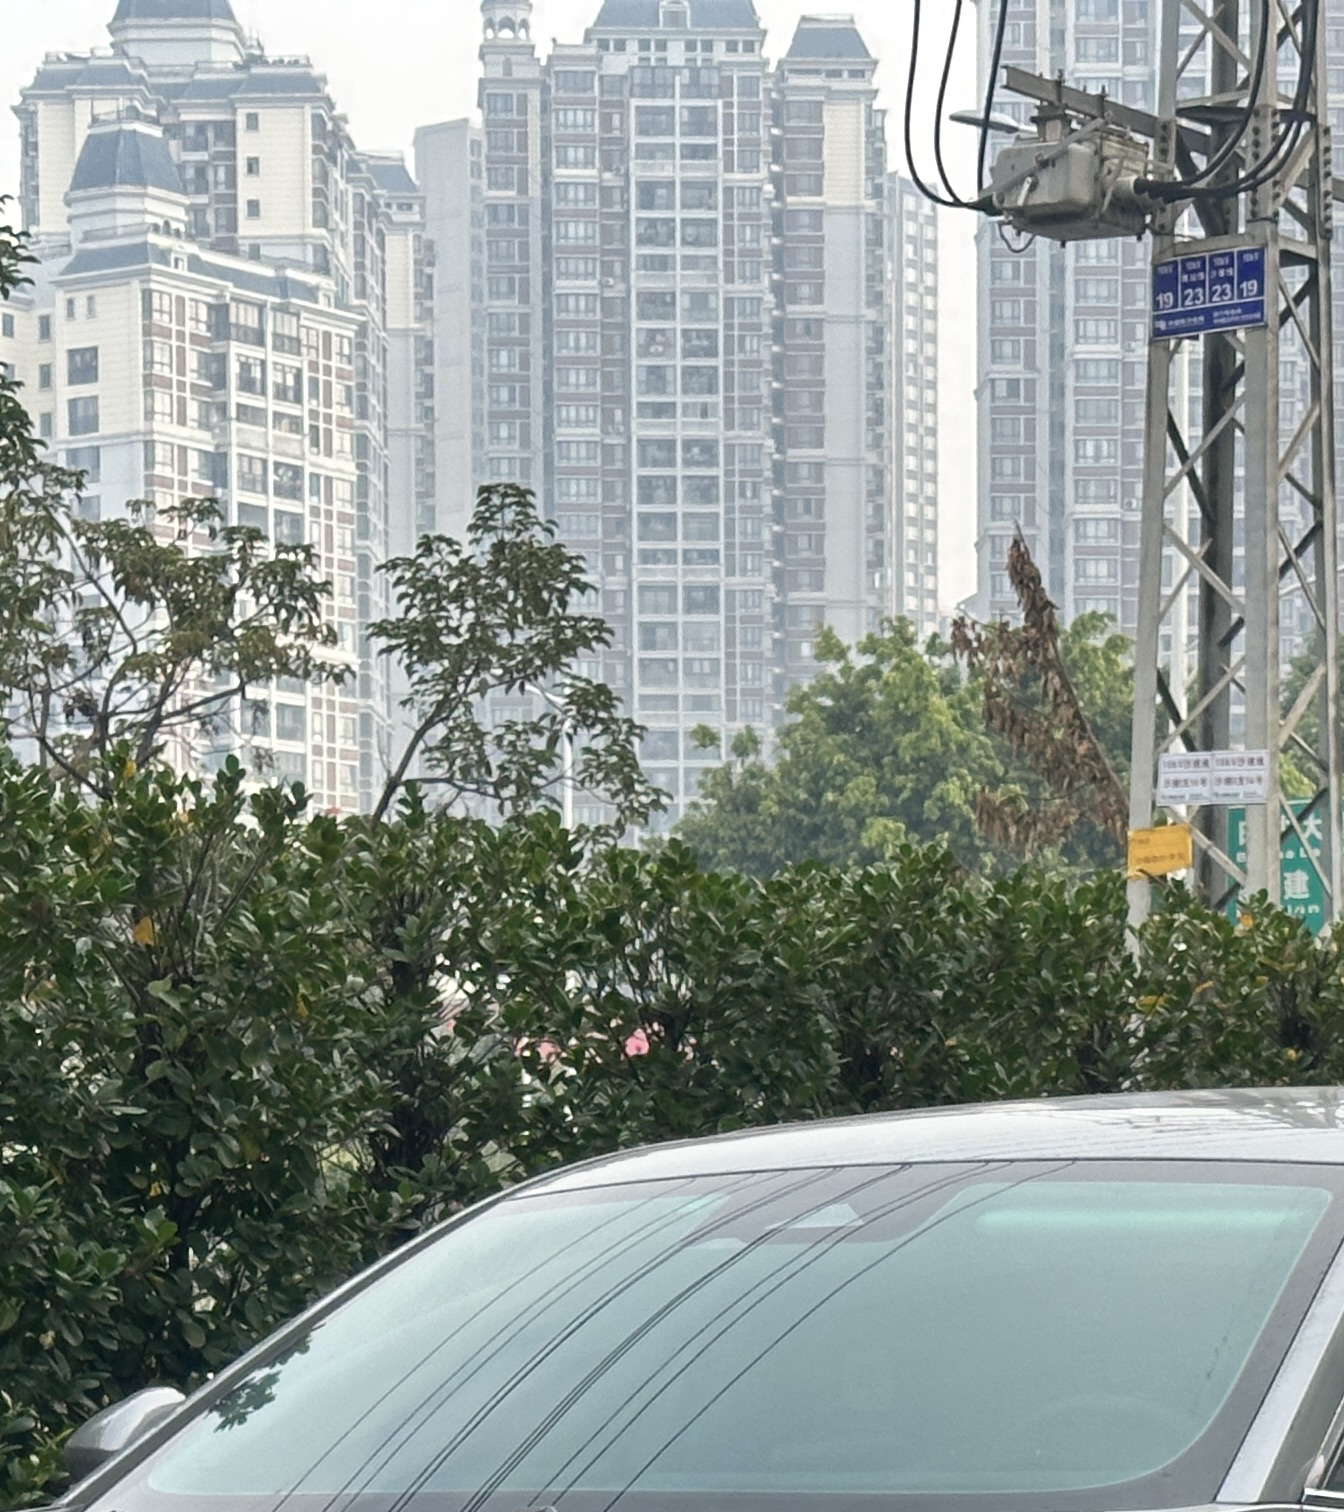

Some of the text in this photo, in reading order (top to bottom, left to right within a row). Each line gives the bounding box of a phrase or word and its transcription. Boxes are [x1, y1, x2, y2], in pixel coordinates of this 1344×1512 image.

[1184, 288, 1204, 306] 23
[1212, 284, 1231, 302] 23
[1240, 279, 1258, 297] 19
[1156, 291, 1174, 309] 19
